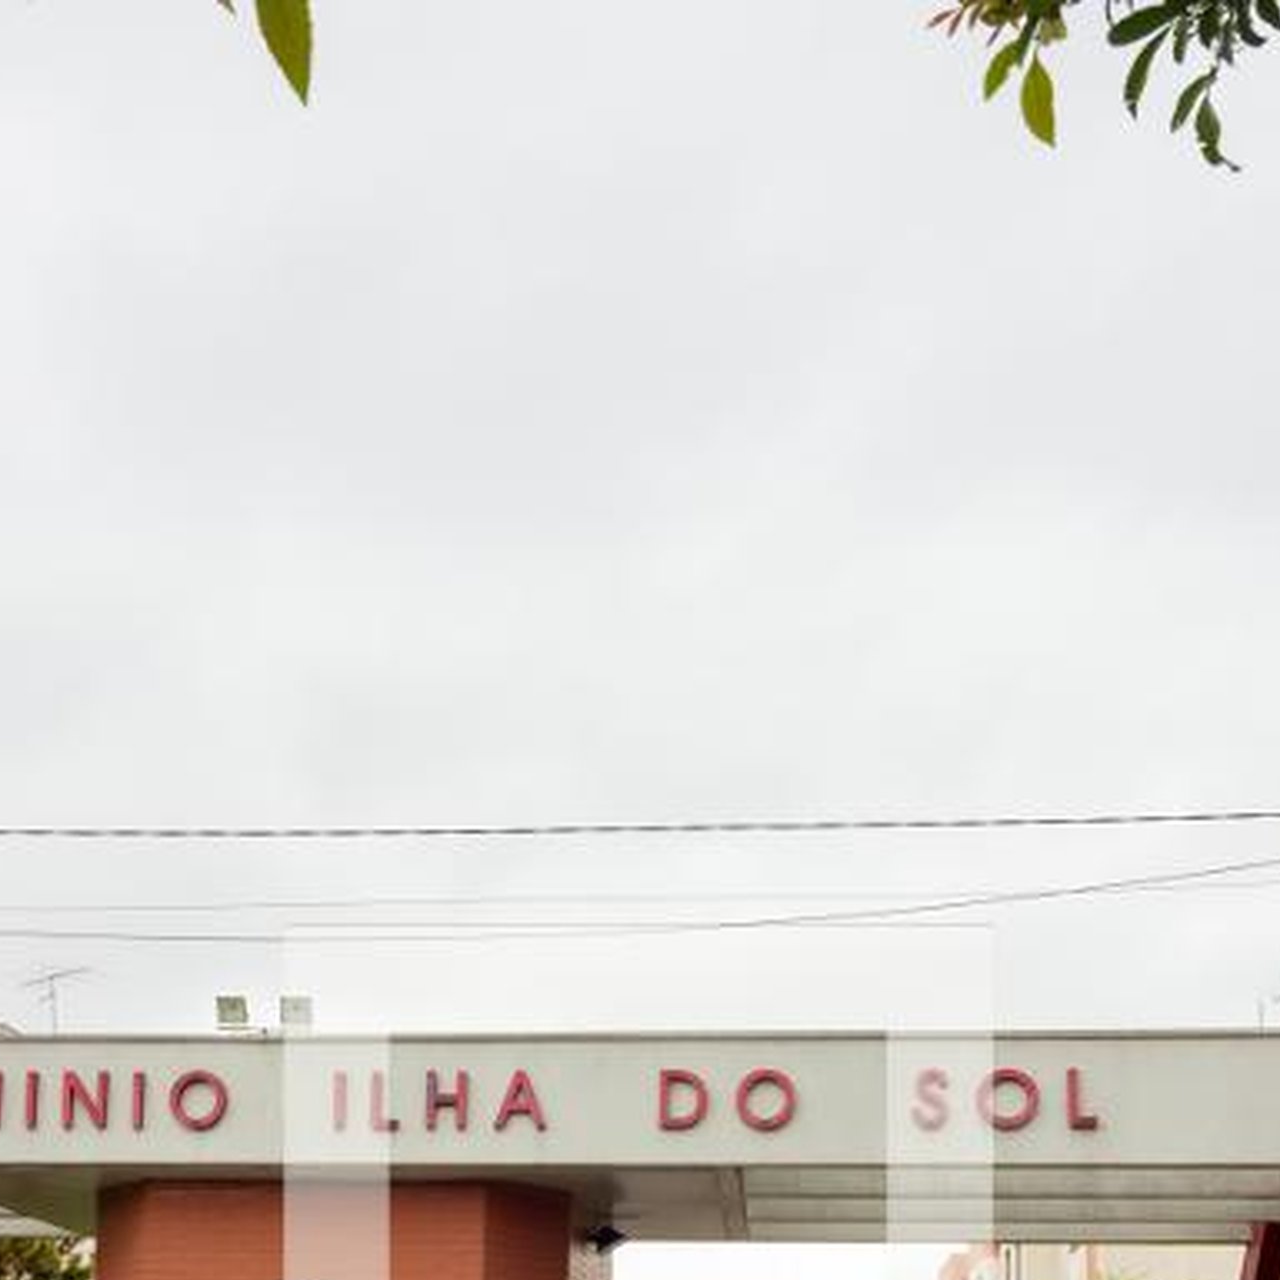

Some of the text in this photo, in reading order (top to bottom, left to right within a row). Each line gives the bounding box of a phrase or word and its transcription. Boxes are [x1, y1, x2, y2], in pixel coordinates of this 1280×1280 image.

[332, 1069, 547, 1133] ILHA
[656, 1069, 797, 1133] DO
[911, 1069, 1101, 1133] SOL
